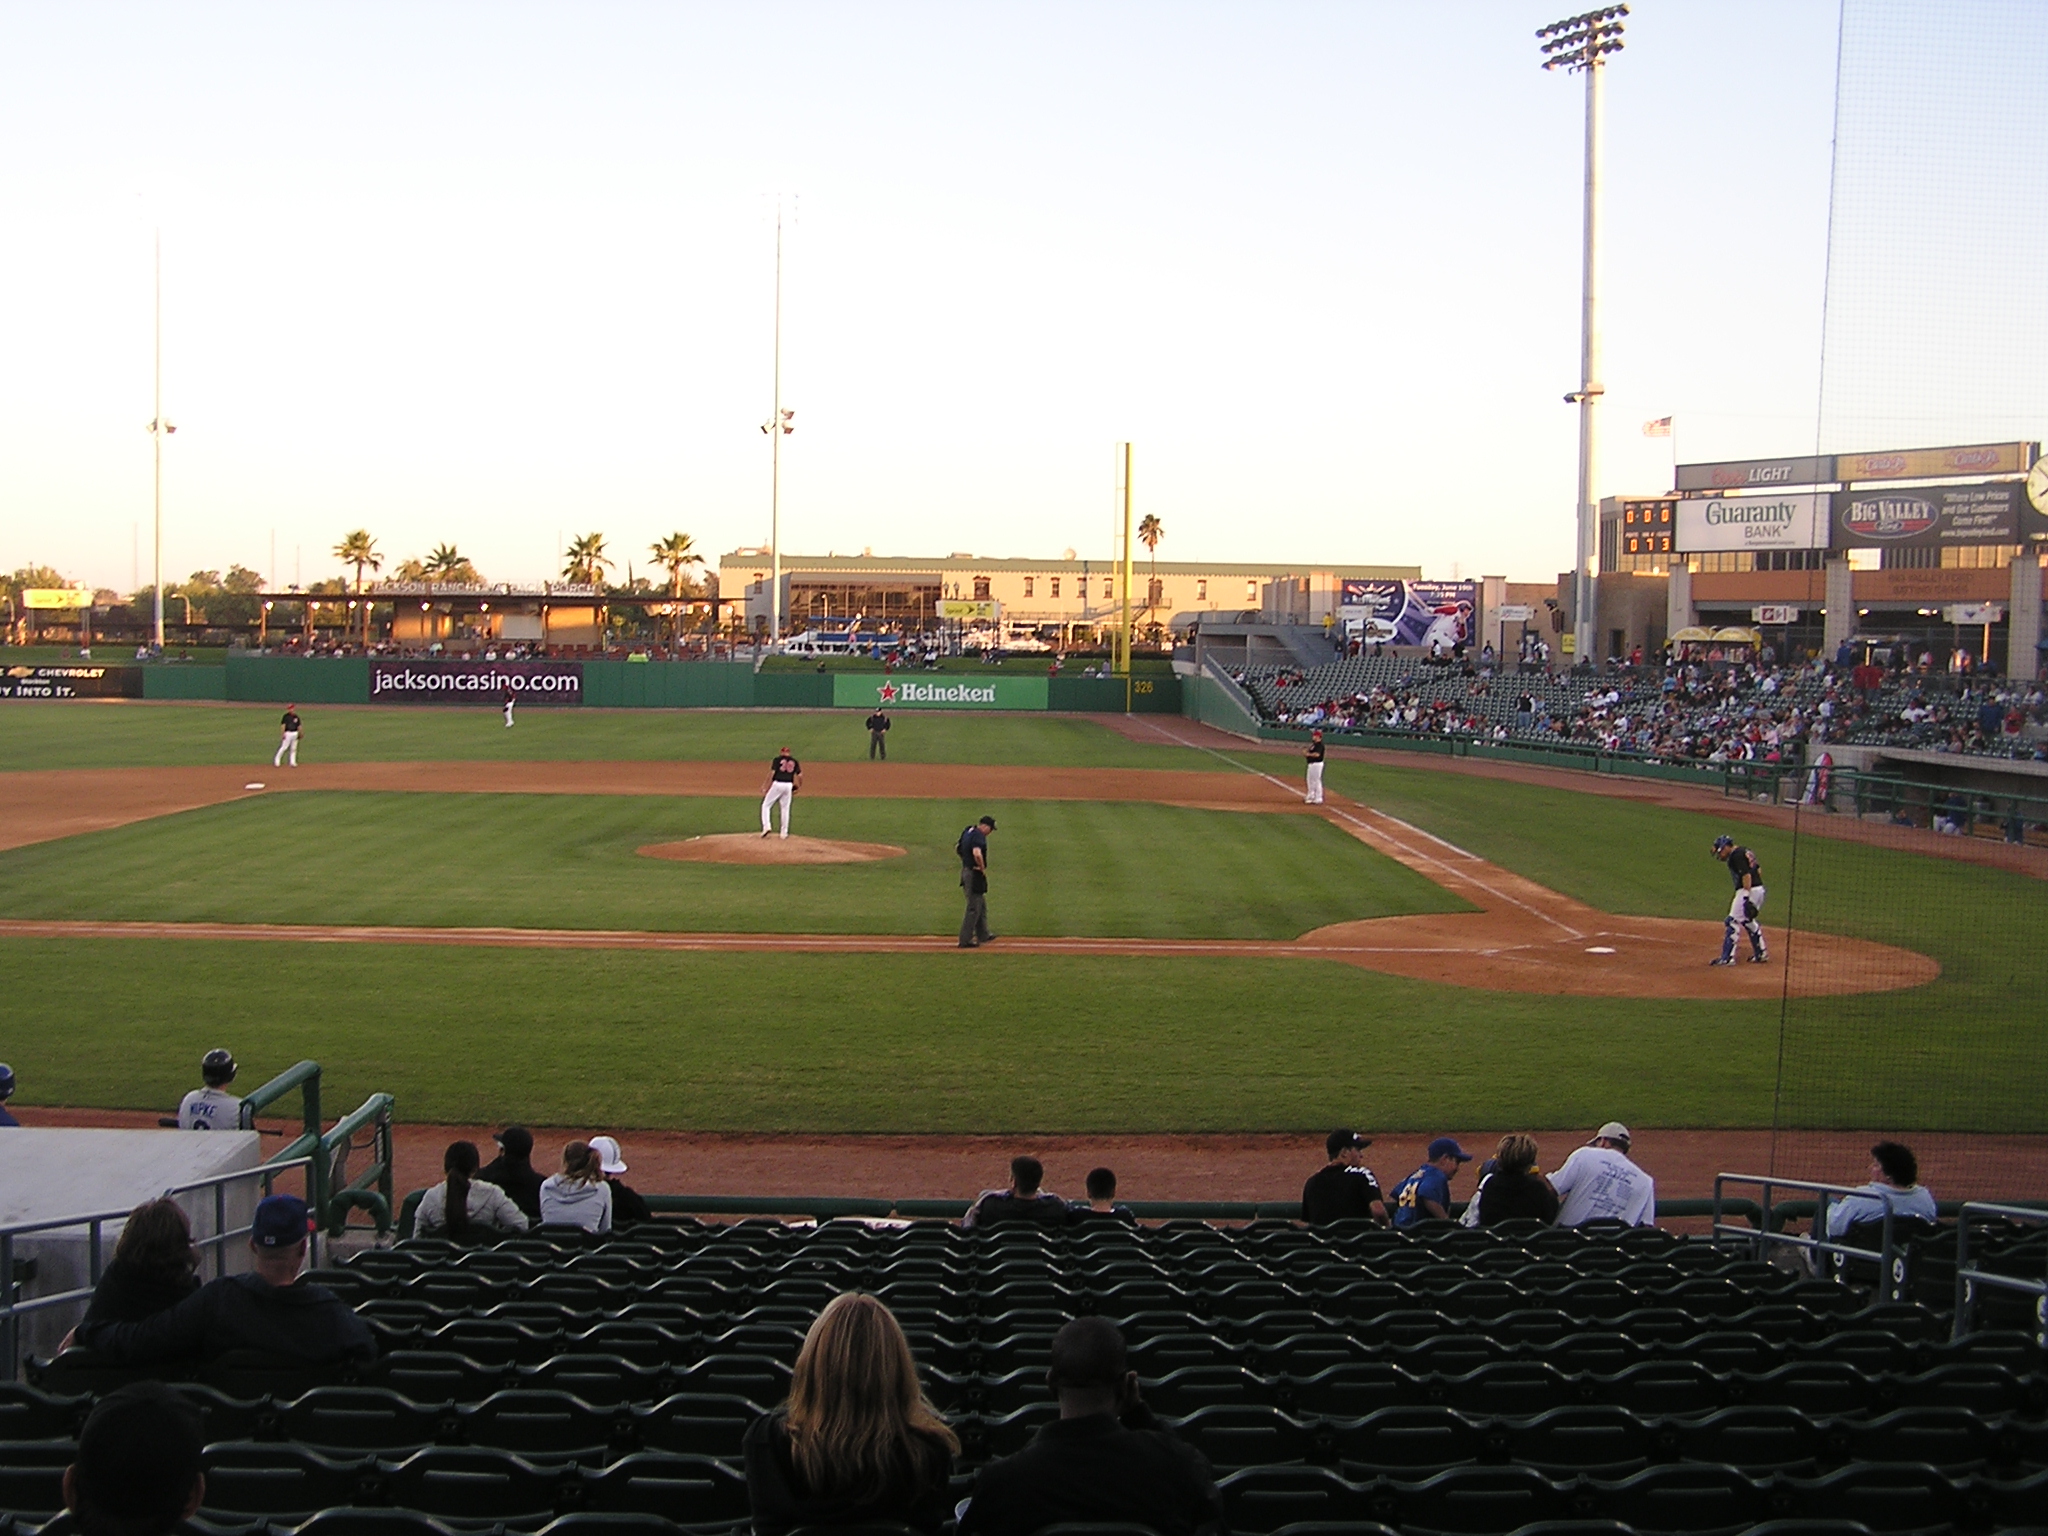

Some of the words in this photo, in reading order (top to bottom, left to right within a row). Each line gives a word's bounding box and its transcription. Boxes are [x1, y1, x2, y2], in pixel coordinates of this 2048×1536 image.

[1748, 466, 1792, 482] LIGHT
[1627, 510, 1634, 523] 0
[1644, 509, 1652, 523] 0
[1661, 509, 1669, 523] 0
[1705, 501, 1797, 530] Guaranty
[1744, 525, 1781, 539] BANK
[38, 668, 105, 678] CHEVROLET
[374, 669, 579, 694] jacksoncasino.com
[16, 686, 52, 697] INTO
[56, 686, 77, 697] IT.
[901, 683, 995, 703] Heineken
